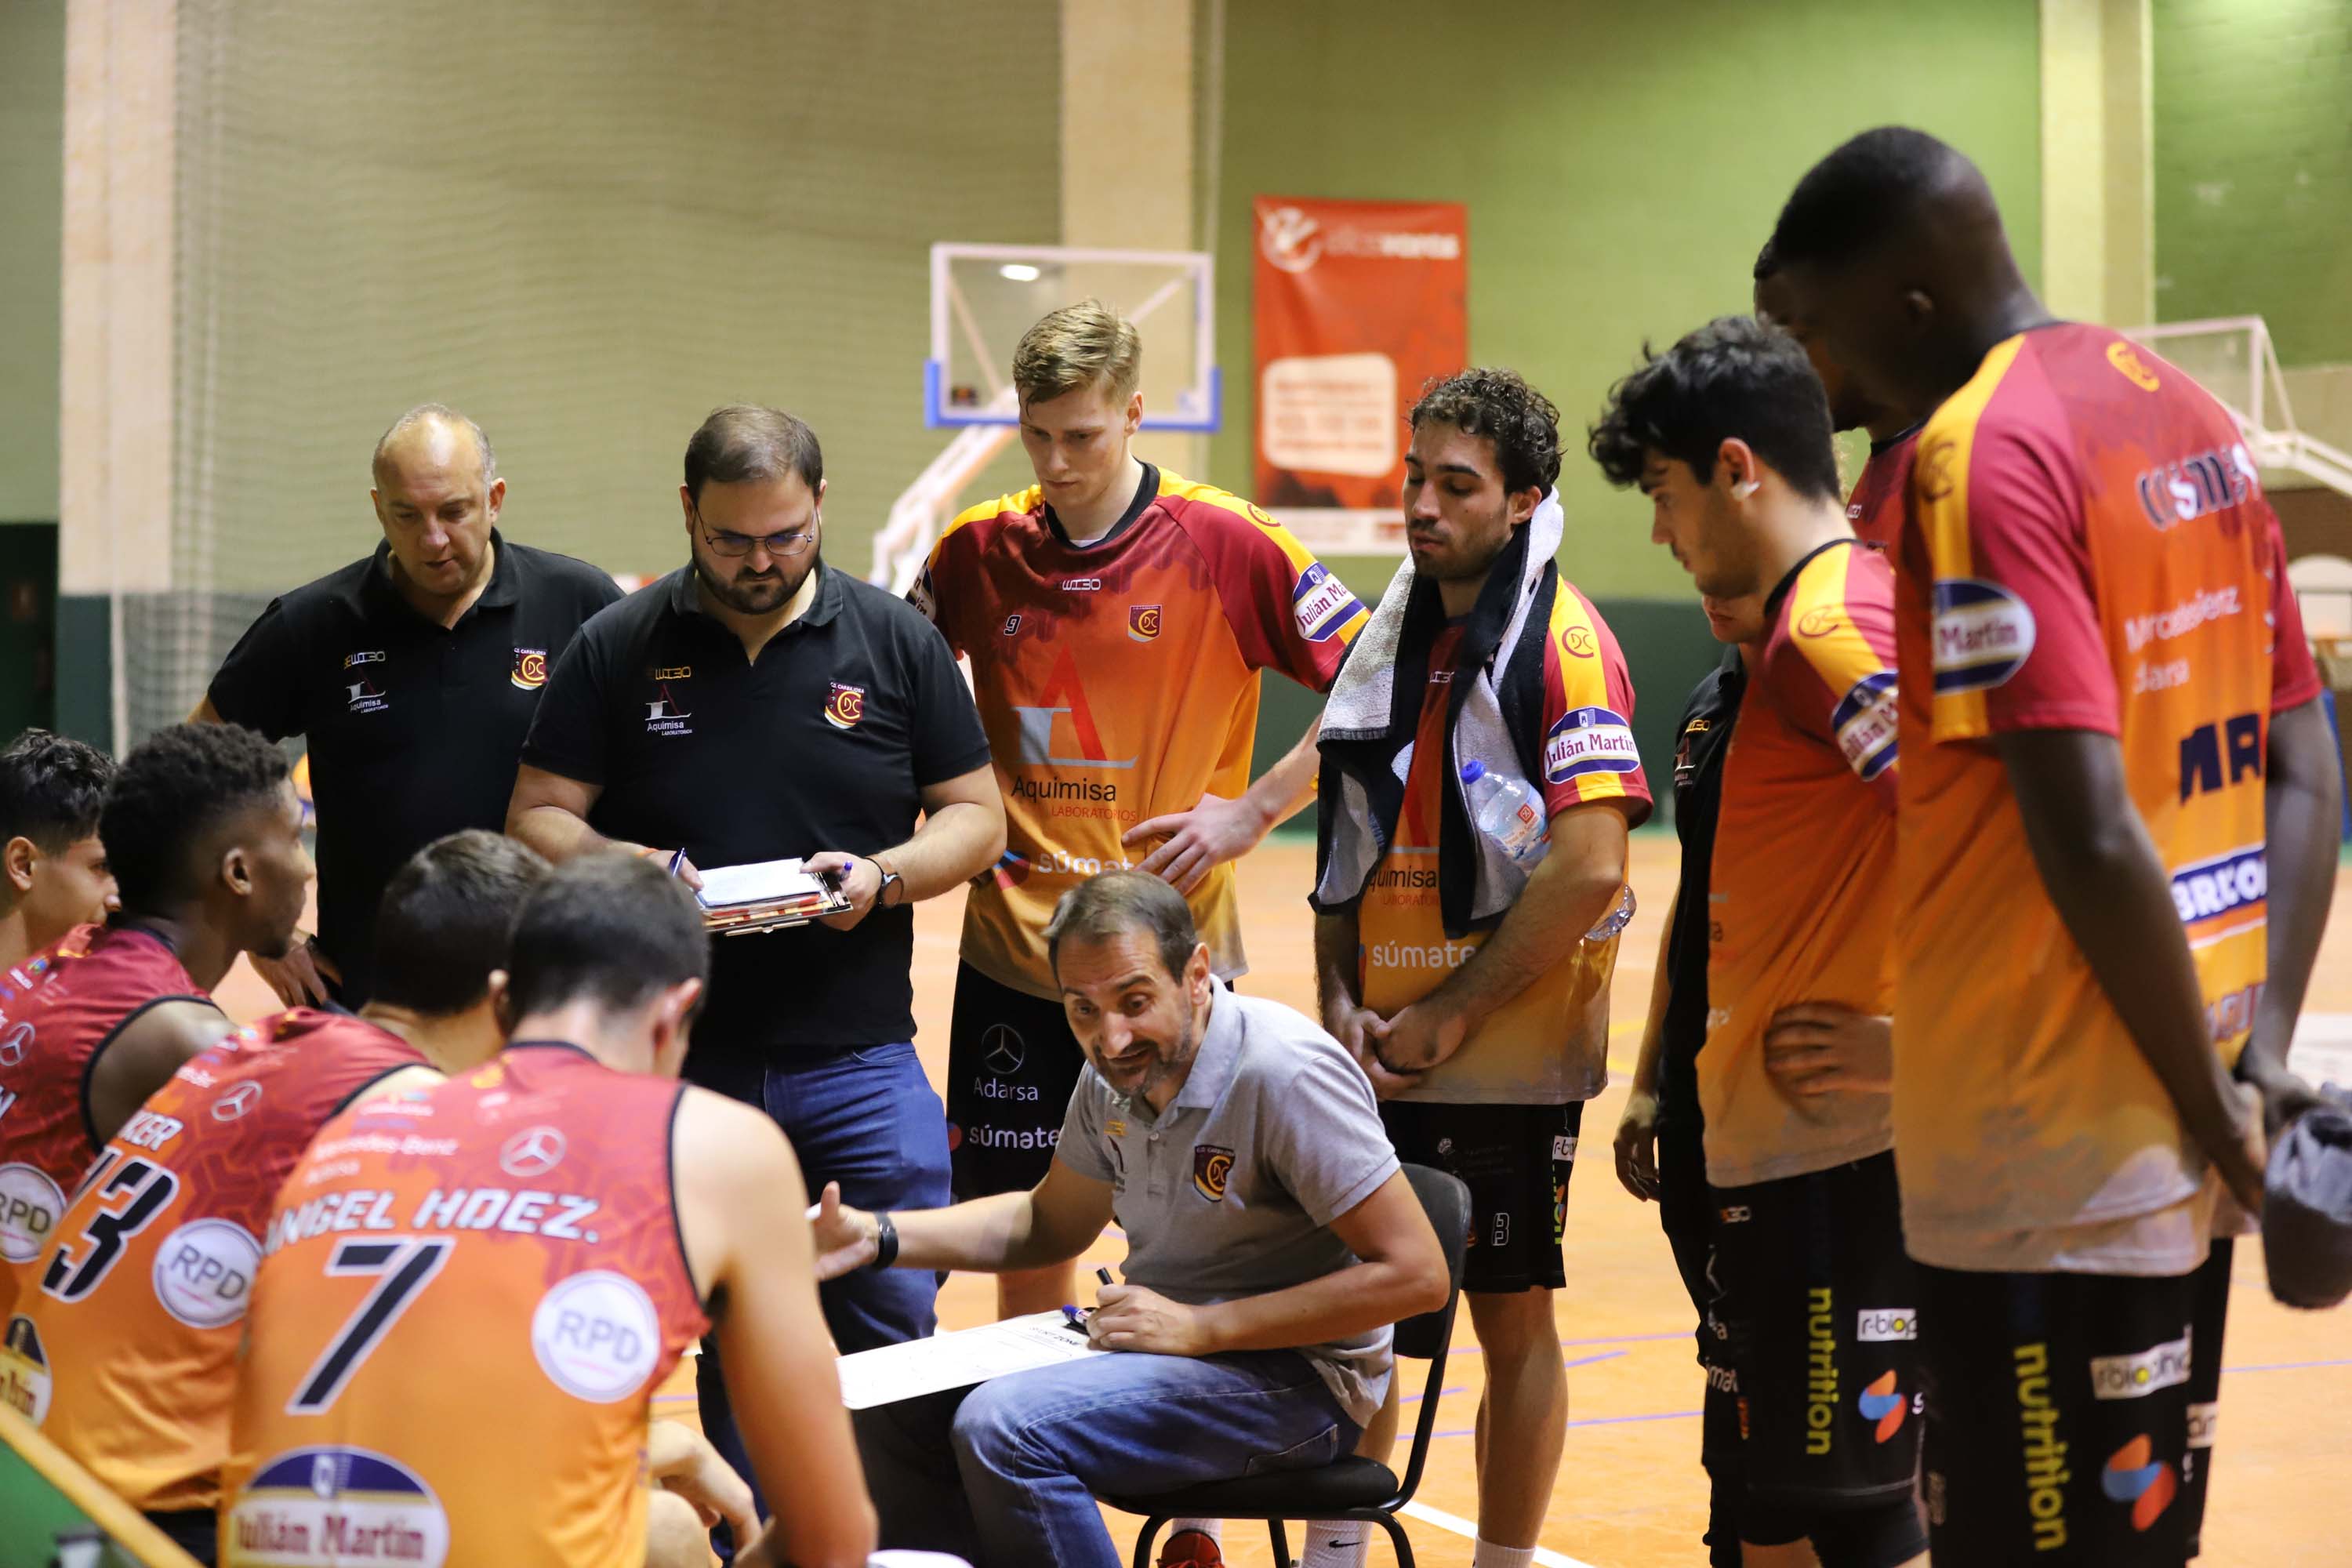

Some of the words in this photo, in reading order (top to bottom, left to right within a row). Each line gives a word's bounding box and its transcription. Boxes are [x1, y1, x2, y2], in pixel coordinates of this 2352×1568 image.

[1004, 615, 1022, 636] 9
[1296, 597, 1332, 633] Julián
[647, 721, 684, 732] Aquimisa
[1546, 739, 1585, 770] Julián
[1589, 733, 1637, 753] Martín
[1011, 776, 1116, 803] Aquimisa
[1051, 806, 1137, 822] LABORATORIOS
[1368, 866, 1437, 893] quimisa
[973, 1076, 1039, 1101] Adarsa
[969, 1124, 1060, 1149] súmate
[169, 1243, 247, 1301] RPD
[285, 1234, 456, 1416] 7
[554, 1309, 642, 1364] RPD
[1806, 1287, 1840, 1455] nutrition
[2013, 1342, 2071, 1552] nutrition
